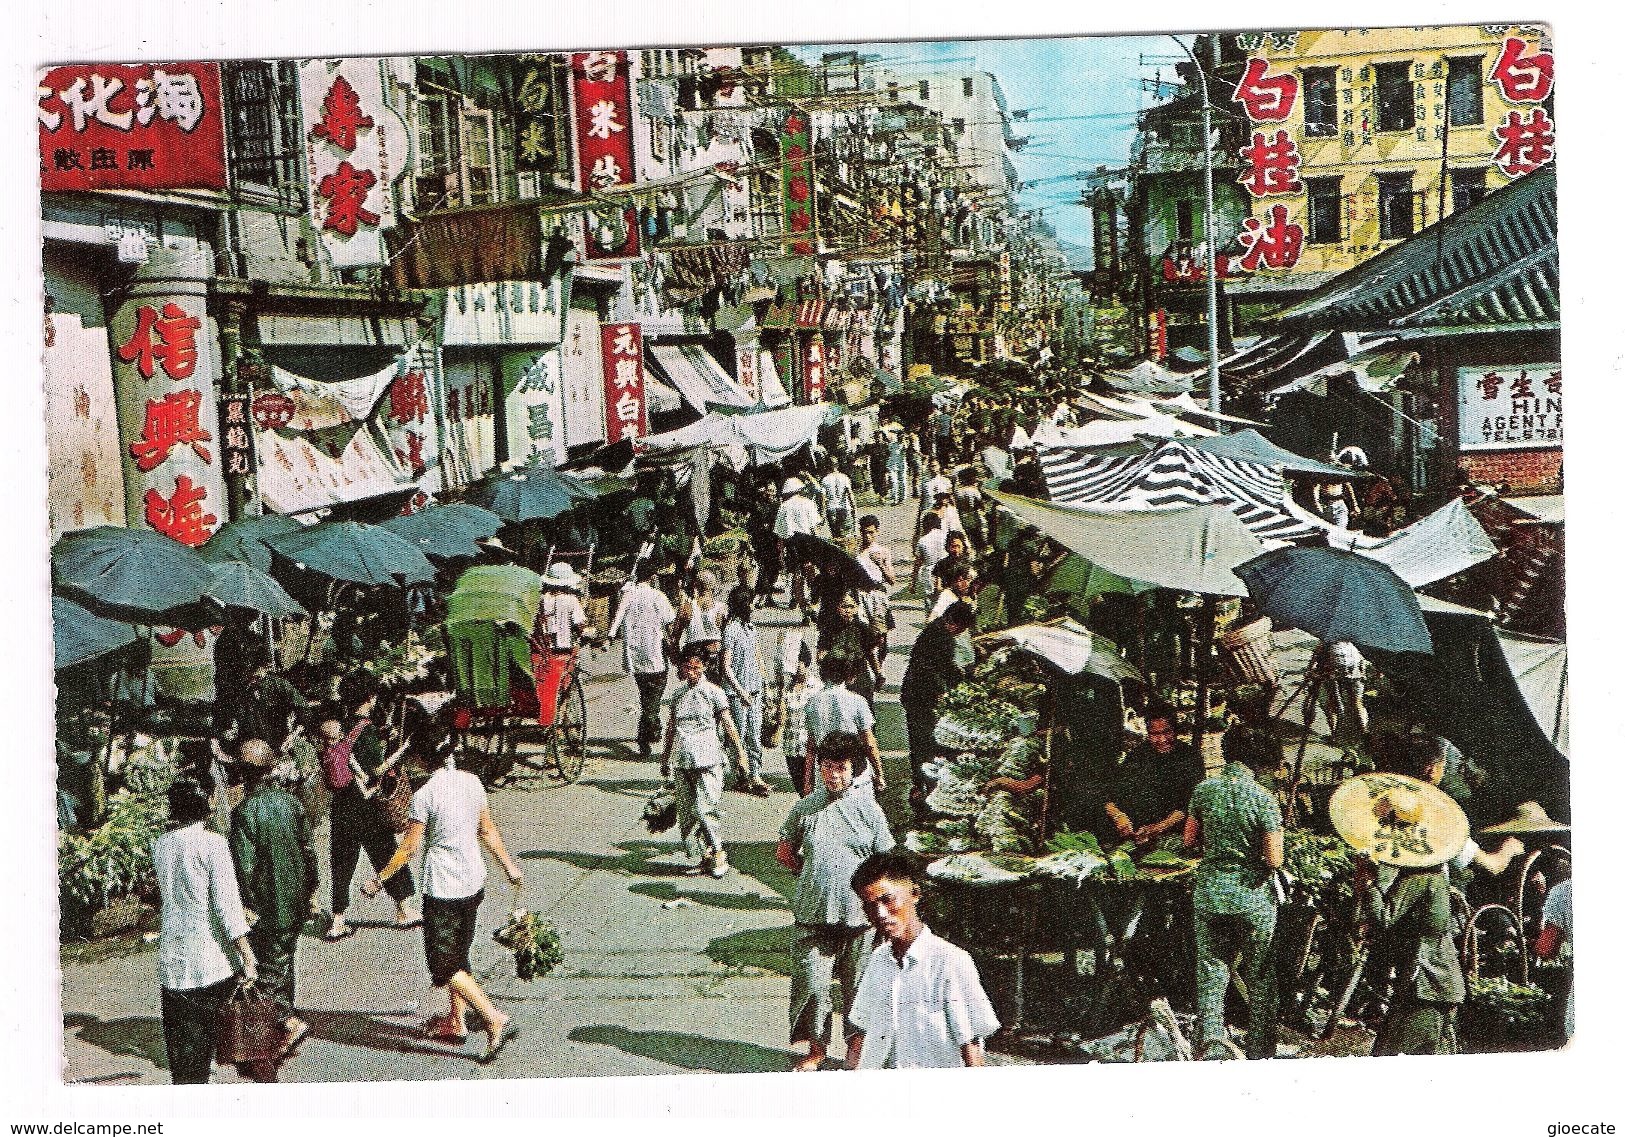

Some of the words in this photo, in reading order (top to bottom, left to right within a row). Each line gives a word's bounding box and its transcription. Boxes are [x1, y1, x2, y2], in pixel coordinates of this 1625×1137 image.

[516, 54, 553, 163] 白米
[1231, 57, 1305, 272] 白桂油
[1481, 415, 1547, 430] AGENT
